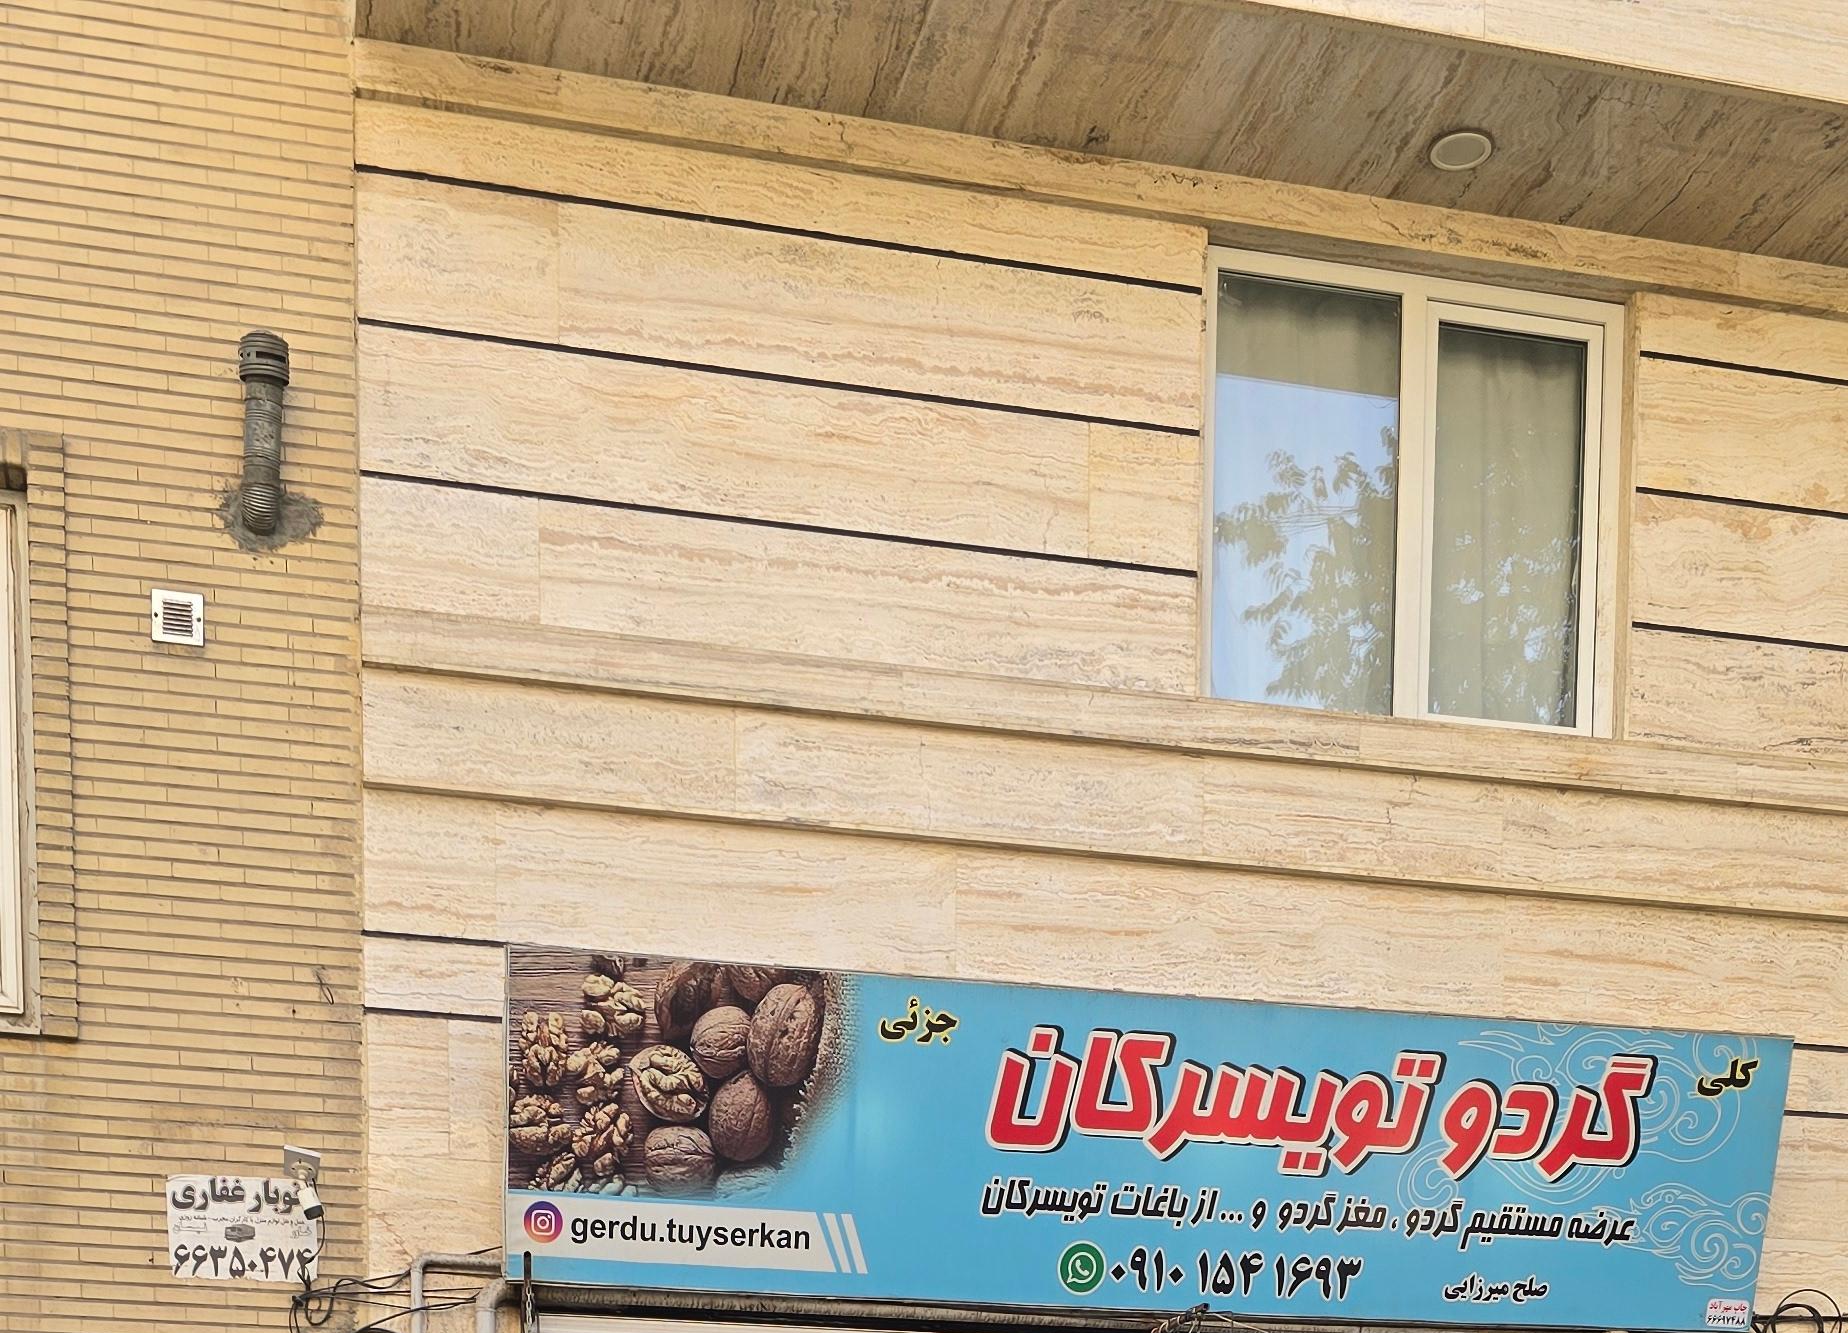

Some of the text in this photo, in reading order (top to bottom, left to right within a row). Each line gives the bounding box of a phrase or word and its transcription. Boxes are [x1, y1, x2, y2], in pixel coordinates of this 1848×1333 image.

[879, 997, 958, 1045] جزئی
[1697, 1058, 1757, 1098] کلی
[986, 1025, 1655, 1179] گردو تویسرکان
[172, 1177, 301, 1213] وبار غفاری
[981, 1178, 1107, 1222] تویسرکان
[1110, 1185, 1189, 1227] باغات
[1191, 1189, 1218, 1224] از
[1279, 1192, 1339, 1231] گردو
[570, 1214, 811, 1252] gerdu.tuyserkan
[1251, 1200, 1266, 1230] و
[1336, 1198, 1387, 1232] مغز
[1407, 1200, 1463, 1237] گردو
[1460, 1203, 1560, 1250] مستقیم
[1567, 1210, 1635, 1245] عرضه
[1111, 1248, 1362, 1300] ۰۹۱۰ ۱۵۴ ۱۶۹۳
[1444, 1273, 1548, 1302] صلح میرزایی
